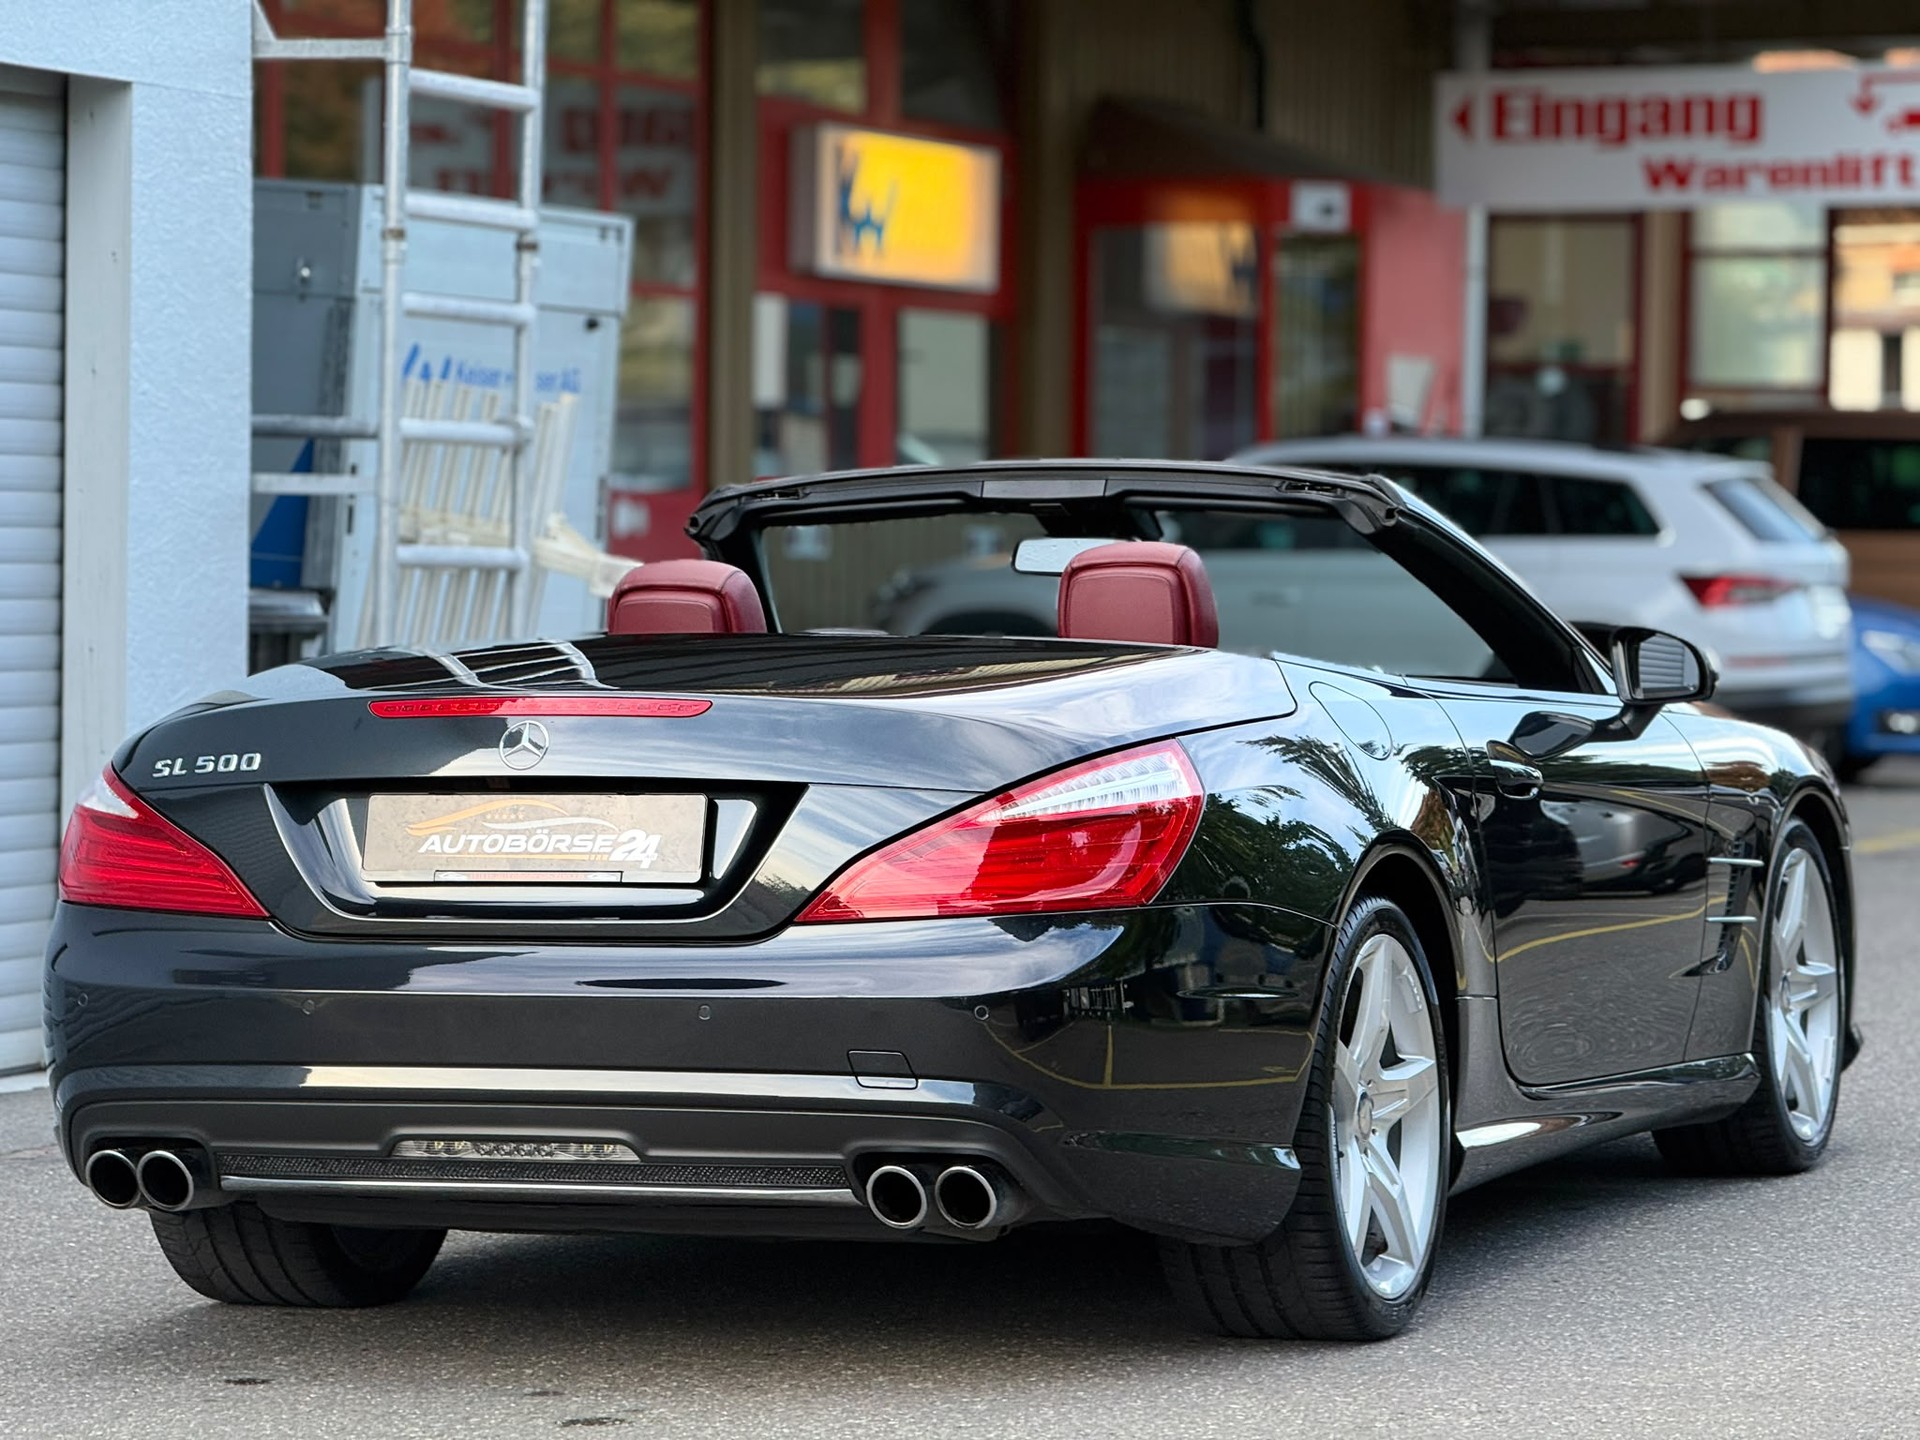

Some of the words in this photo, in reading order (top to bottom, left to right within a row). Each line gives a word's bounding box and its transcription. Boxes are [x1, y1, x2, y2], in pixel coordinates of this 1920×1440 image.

[1491, 87, 1764, 147] Eingang
[1642, 154, 1915, 190] Warenlift
[152, 758, 187, 777] SL
[194, 753, 261, 773] 500
